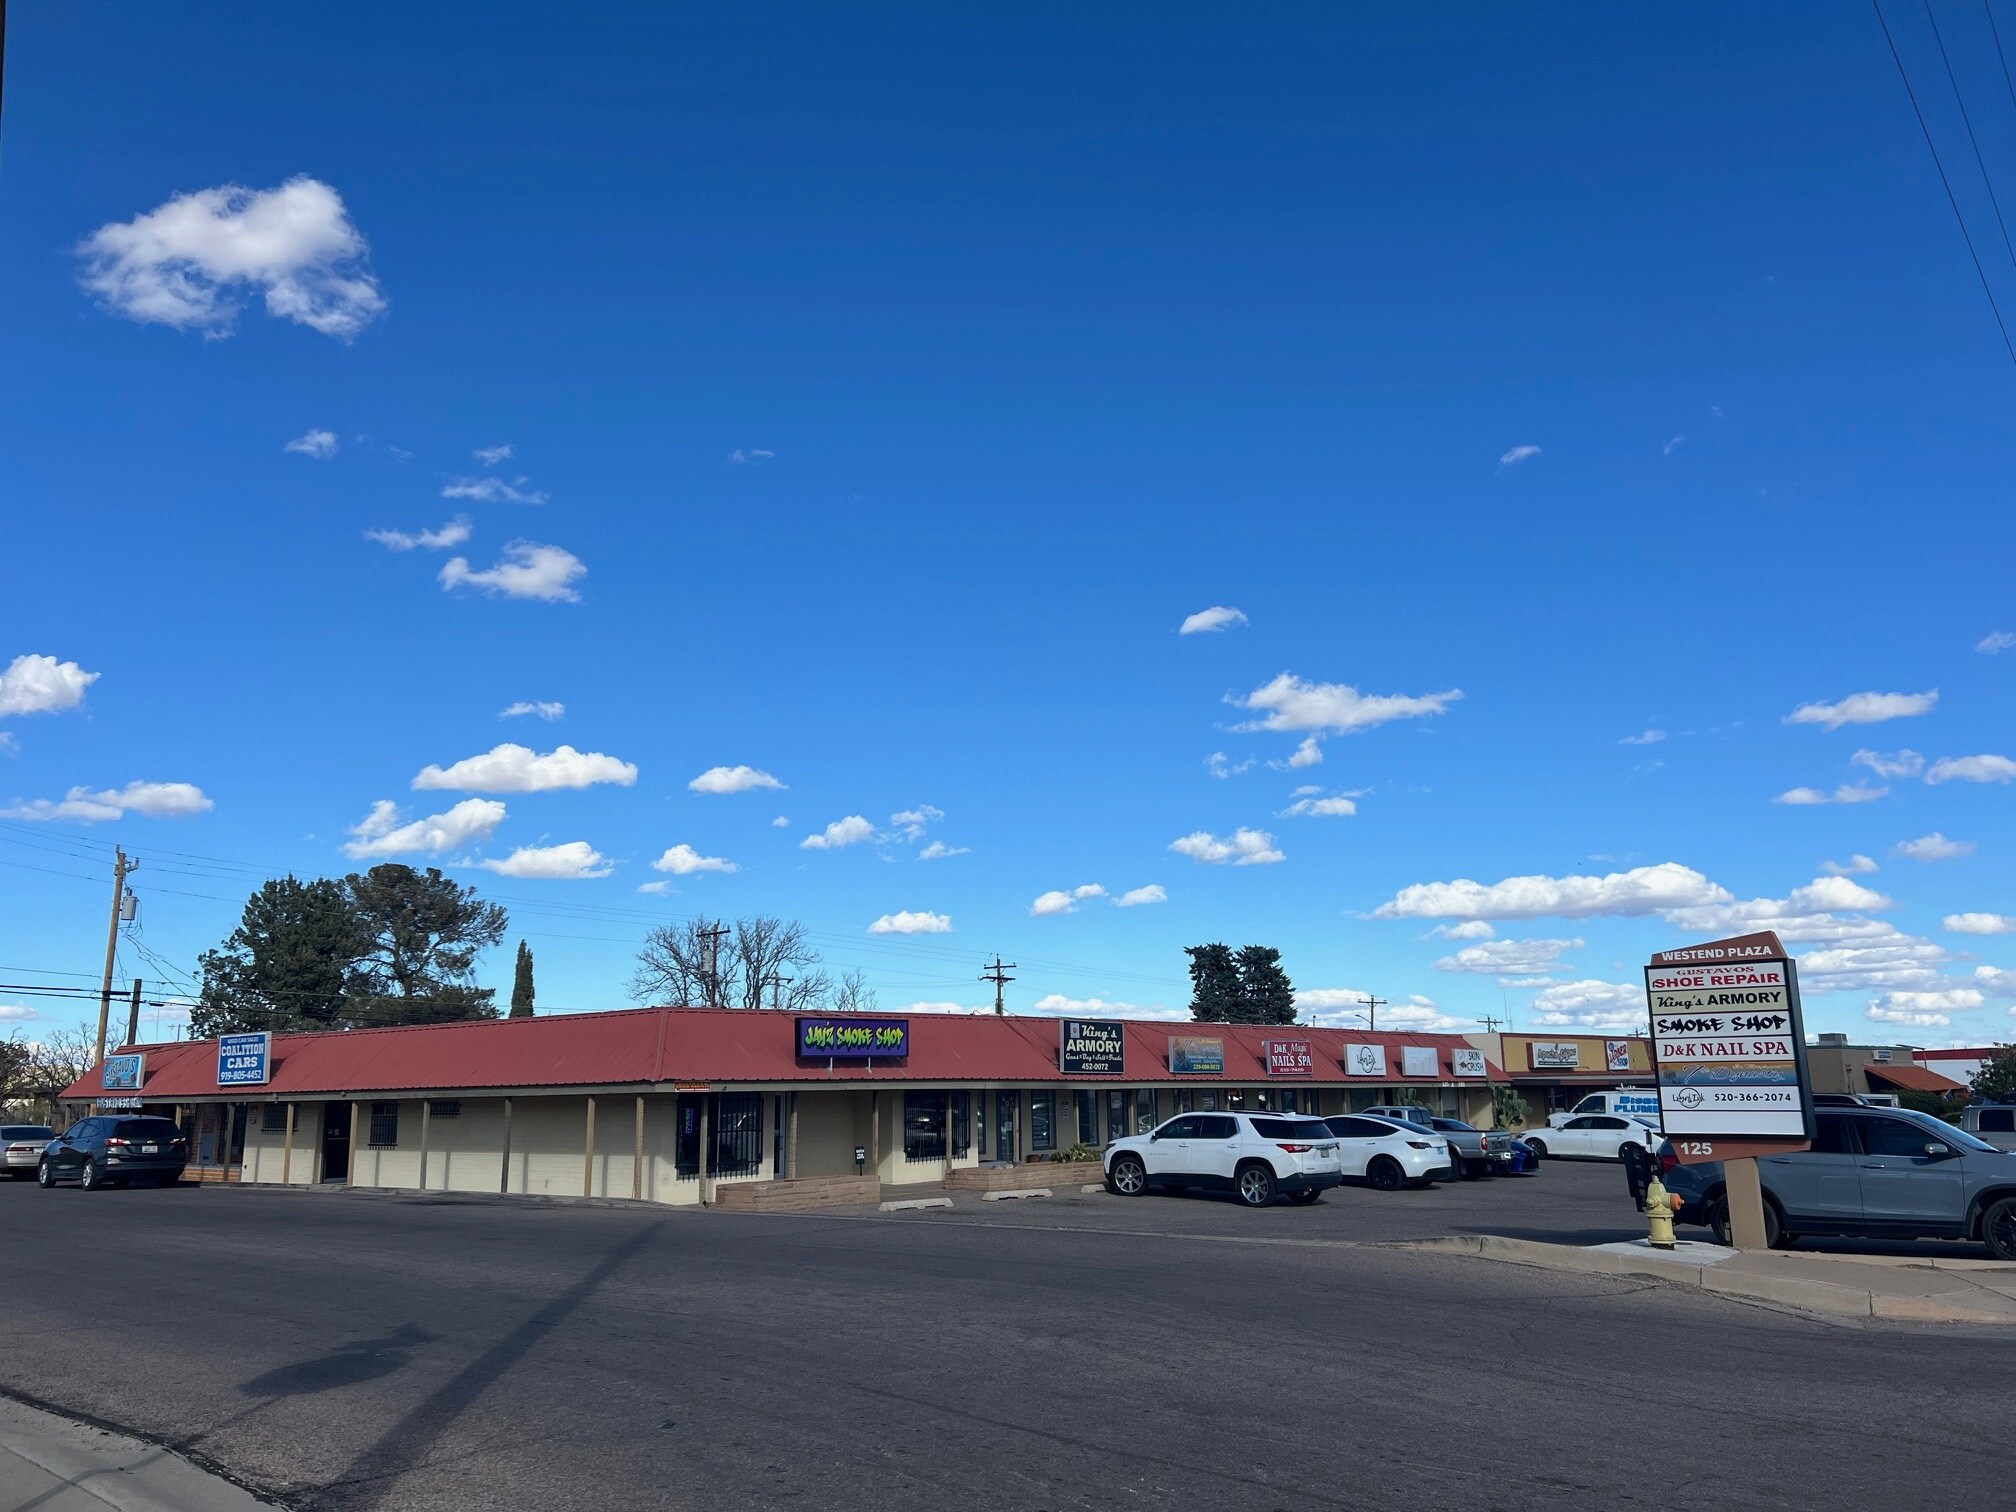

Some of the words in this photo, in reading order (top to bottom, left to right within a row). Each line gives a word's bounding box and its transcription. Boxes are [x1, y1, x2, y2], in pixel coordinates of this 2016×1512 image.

[1662, 949, 1724, 961] WESTEND
[1728, 945, 1772, 957] PLAZA
[1676, 966, 1755, 976] GUSTAVOS
[1654, 977, 1704, 988] SHOE
[1711, 973, 1780, 985] REPAIR
[1657, 995, 1704, 1009] King's
[1707, 992, 1781, 1005] ARMORY
[1656, 1017, 1726, 1035] SMOKE
[1731, 1014, 1787, 1032] SHOP
[836, 1026, 874, 1048] SMOKE
[875, 1026, 904, 1048] SHOP
[1081, 1025, 1117, 1040] King's
[221, 1043, 264, 1057] COALITION
[1066, 1039, 1121, 1053] ARMORY
[1663, 1043, 1697, 1057] D&K
[1700, 1042, 1749, 1056] NAIL
[1753, 1041, 1790, 1055] SPA
[227, 1056, 258, 1068] CARS
[1272, 1055, 1295, 1067] NAILS
[1297, 1055, 1312, 1066] SPA
[1467, 1062, 1484, 1072] CRUSH
[1714, 1093, 1792, 1102] 520-366-2074
[1680, 1142, 1713, 1155] 125
